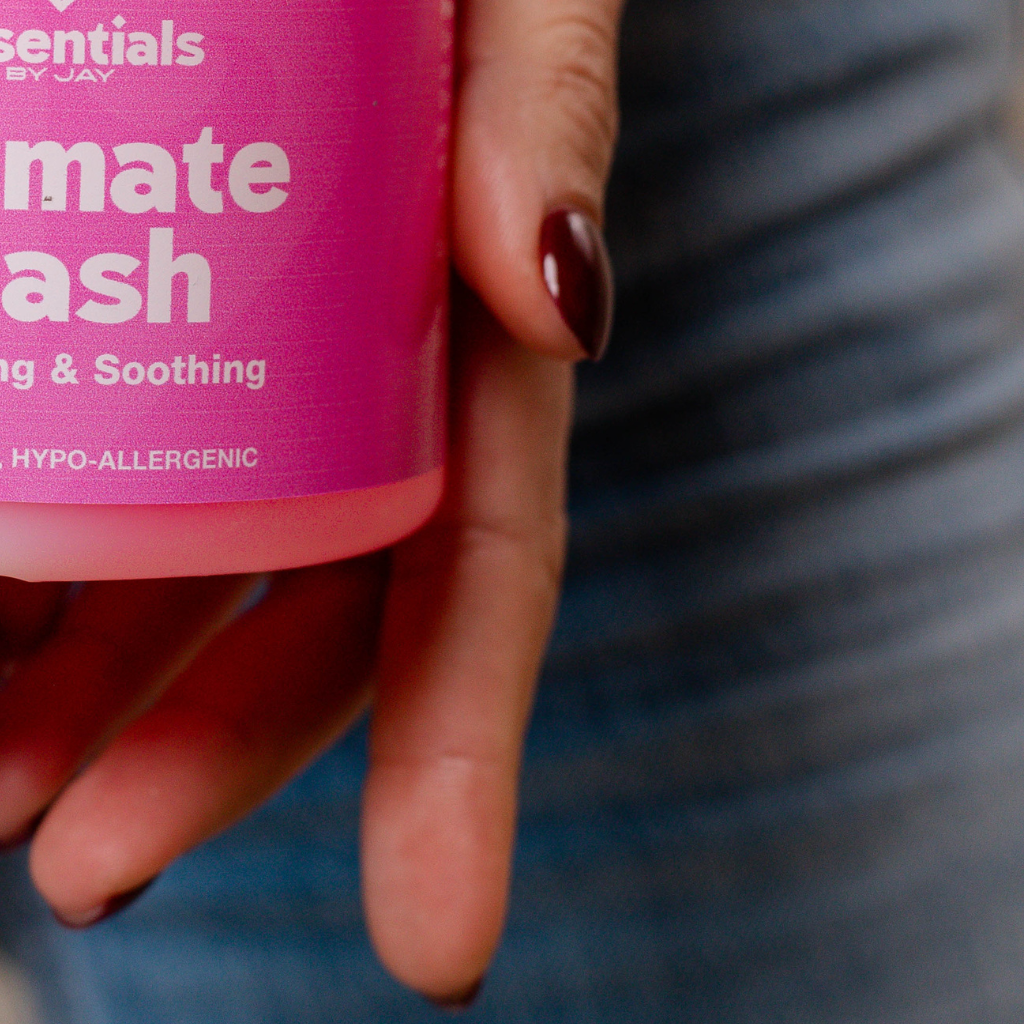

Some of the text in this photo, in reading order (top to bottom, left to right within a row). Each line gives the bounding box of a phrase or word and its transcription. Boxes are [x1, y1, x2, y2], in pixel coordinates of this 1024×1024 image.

[5, 66, 116, 83] BY JAY
[50, 352, 79, 386] &
[93, 353, 267, 391] Soothing
[11, 446, 259, 472] HYPO-ALLERGENIC
